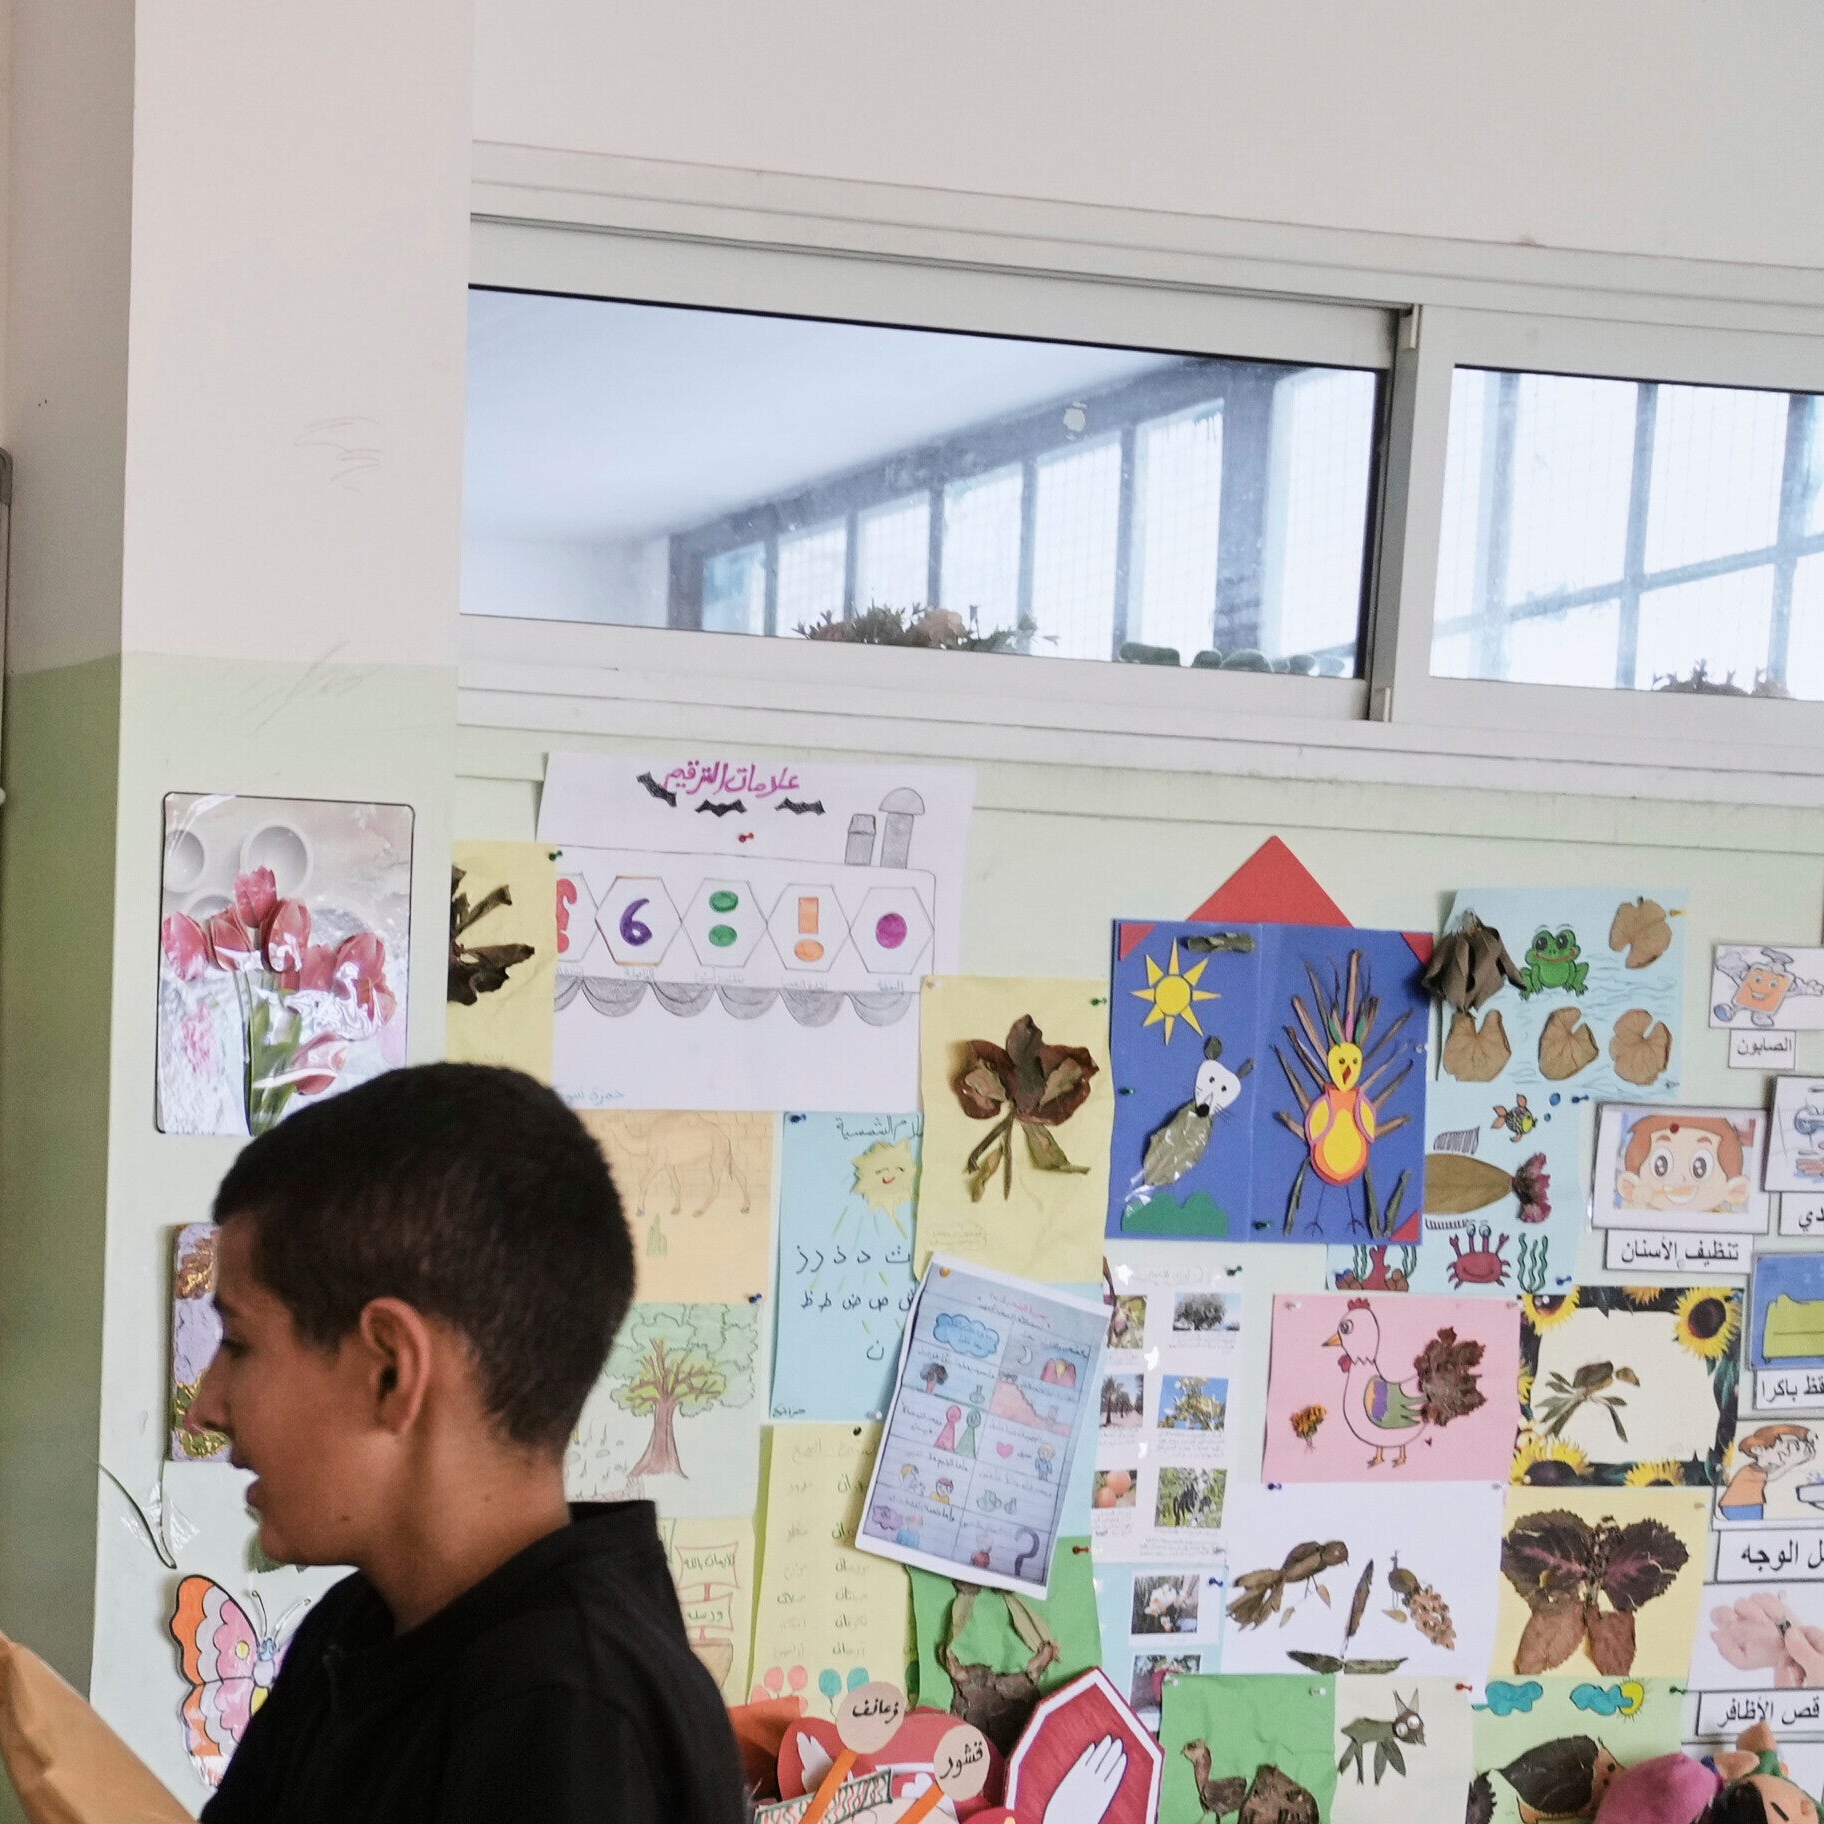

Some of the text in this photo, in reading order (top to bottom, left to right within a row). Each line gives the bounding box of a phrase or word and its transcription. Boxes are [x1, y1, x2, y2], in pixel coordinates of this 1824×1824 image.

[1737, 1037, 1792, 1055] الصابون
[1685, 1241, 1739, 1267] تنظيف
[1740, 1539, 1798, 1572] الوجه
[1781, 1695, 1820, 1726] قص
